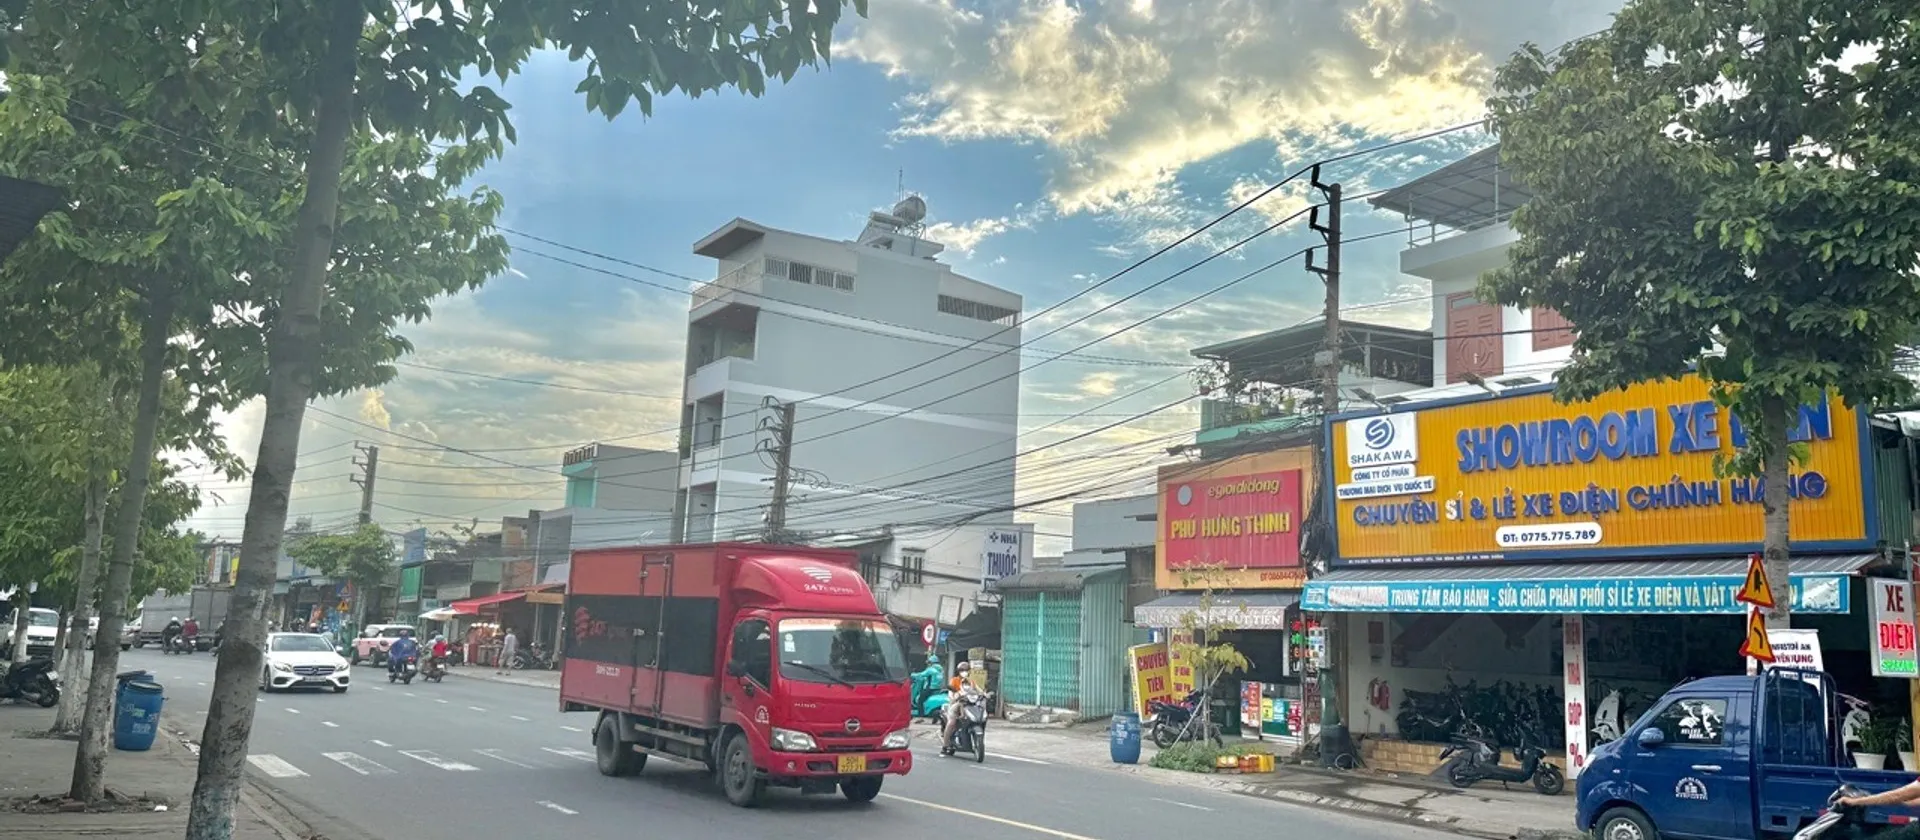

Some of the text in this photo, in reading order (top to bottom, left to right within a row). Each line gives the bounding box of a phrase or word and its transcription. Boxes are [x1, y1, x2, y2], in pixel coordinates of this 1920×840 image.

[1457, 407, 1659, 473] SHOWROOM
[1668, 400, 1720, 454] XE
[1351, 450, 1412, 464] SHAKAWA
[1354, 472, 1371, 481] CÔNG
[1373, 470, 1380, 479] TY
[1353, 497, 1438, 526] CHUYÊN
[1470, 497, 1487, 519] &
[1492, 487, 1517, 520] LẺ
[1521, 492, 1554, 518] XE
[1559, 482, 1620, 519] ĐIỆN
[1626, 474, 1722, 510] CHÍNH
[1171, 513, 1196, 539] PHÚ
[1245, 511, 1291, 539] THỊNH
[1502, 530, 1596, 544] ĐT: 0775.775.789
[987, 545, 1017, 576] THUỐC
[1391, 589, 1419, 606] TRUNG
[1421, 585, 1441, 606] TÂM
[1443, 584, 1461, 606] BẢO
[1463, 585, 1490, 606] HÀNH
[1498, 582, 1517, 606] SỬA
[1519, 584, 1546, 606] CHỮA
[1550, 584, 1577, 606] PHÂN
[1580, 581, 1604, 606] PHỐI
[1621, 581, 1634, 606] LẺ
[1637, 587, 1651, 606] XE
[1654, 583, 1681, 611] ĐIỆN
[1684, 582, 1700, 607] VÀ
[1702, 582, 1725, 611] VẬT
[1885, 585, 1904, 612] XE
[1880, 618, 1914, 656] ĐIỆN
